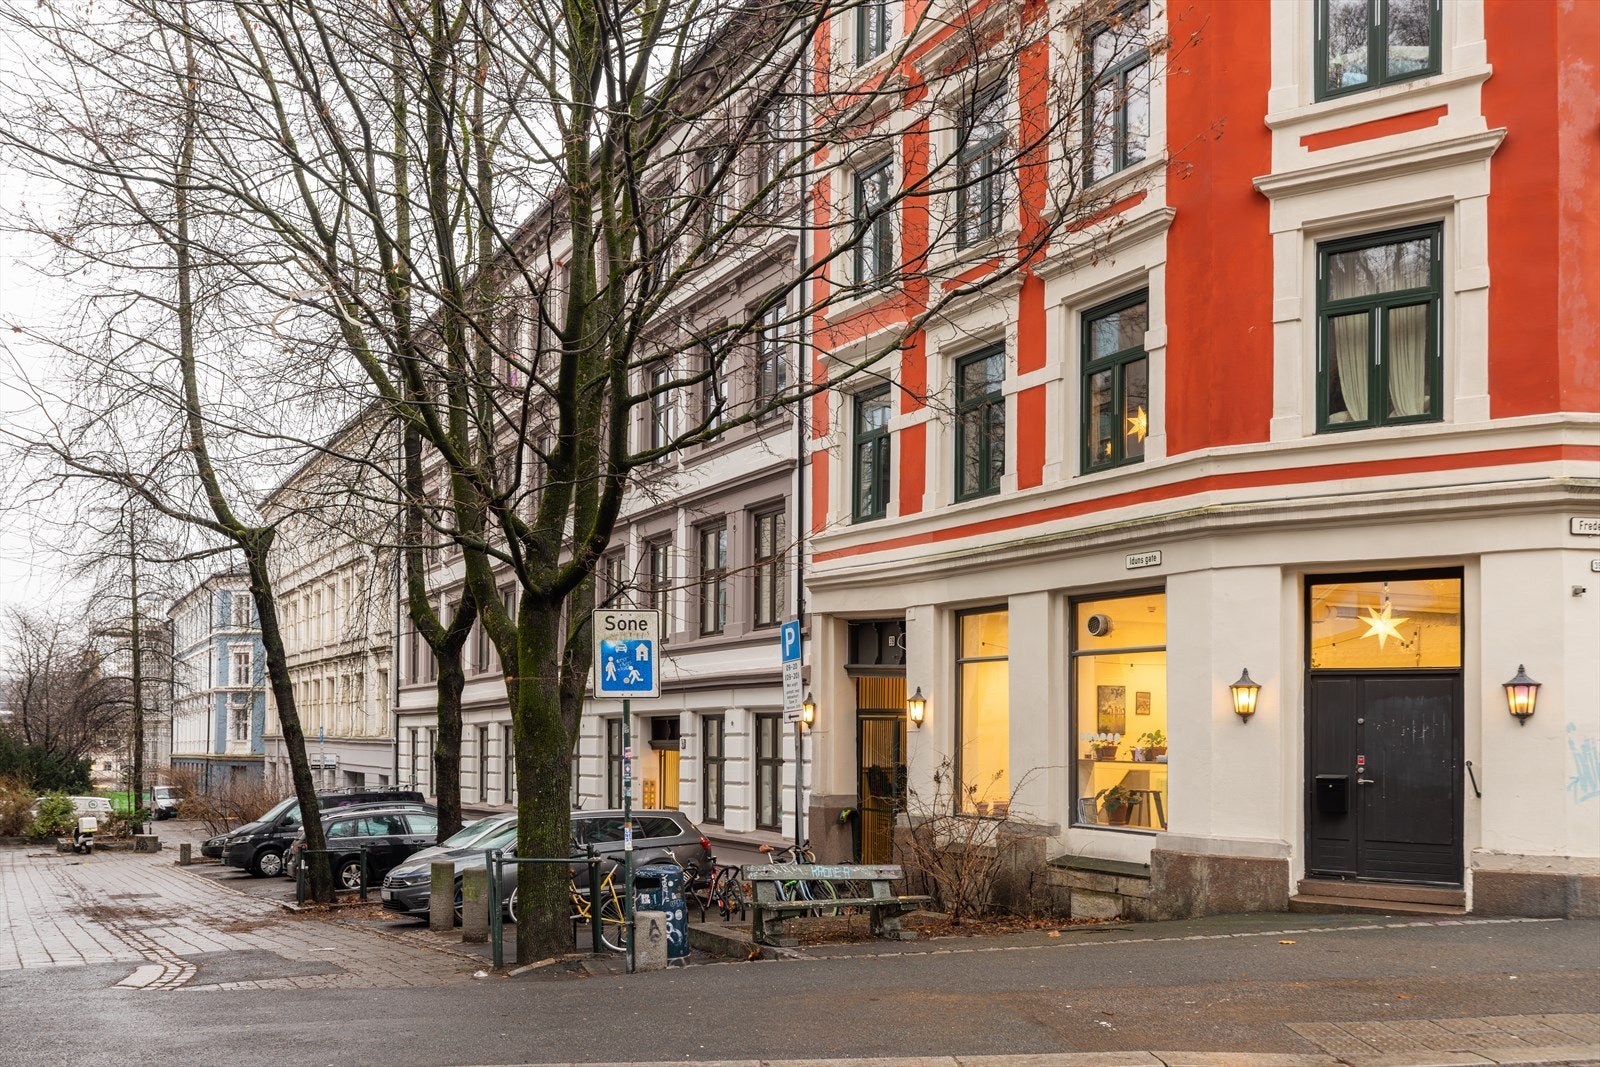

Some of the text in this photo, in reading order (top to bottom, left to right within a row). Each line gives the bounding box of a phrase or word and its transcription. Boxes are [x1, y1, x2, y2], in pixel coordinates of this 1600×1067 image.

[1129, 554, 1157, 566] Iduns gate
[604, 615, 648, 631] Sone
[785, 627, 796, 657] P
